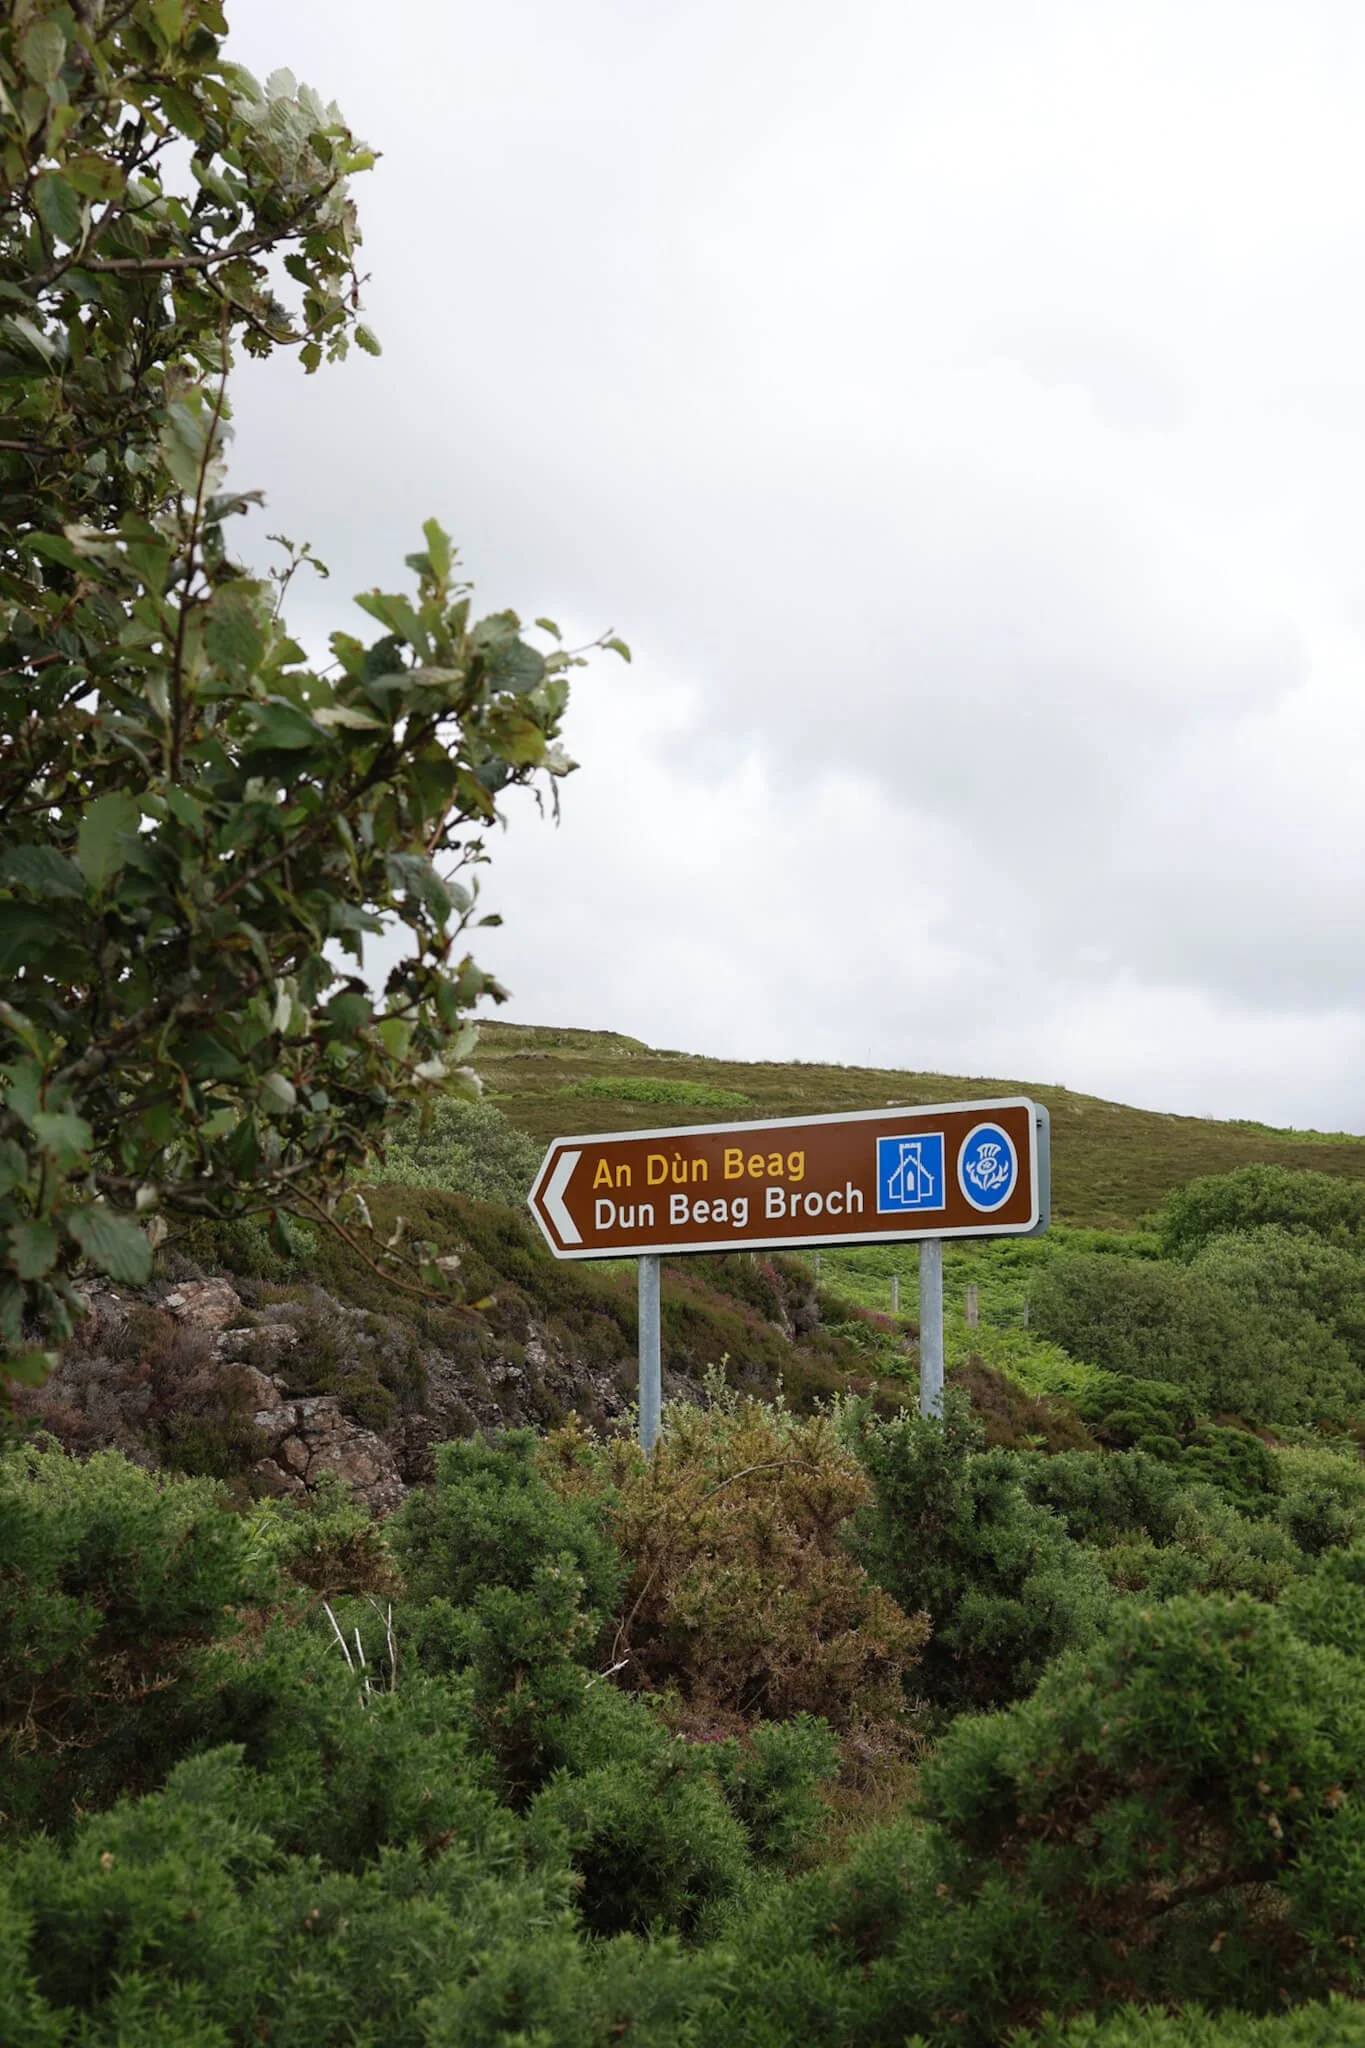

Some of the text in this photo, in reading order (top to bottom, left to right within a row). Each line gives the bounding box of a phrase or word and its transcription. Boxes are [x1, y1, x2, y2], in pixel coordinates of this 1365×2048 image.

[592, 1149, 805, 1189] An Dùn Beag
[595, 1182, 864, 1230] Dun Beag Broch
